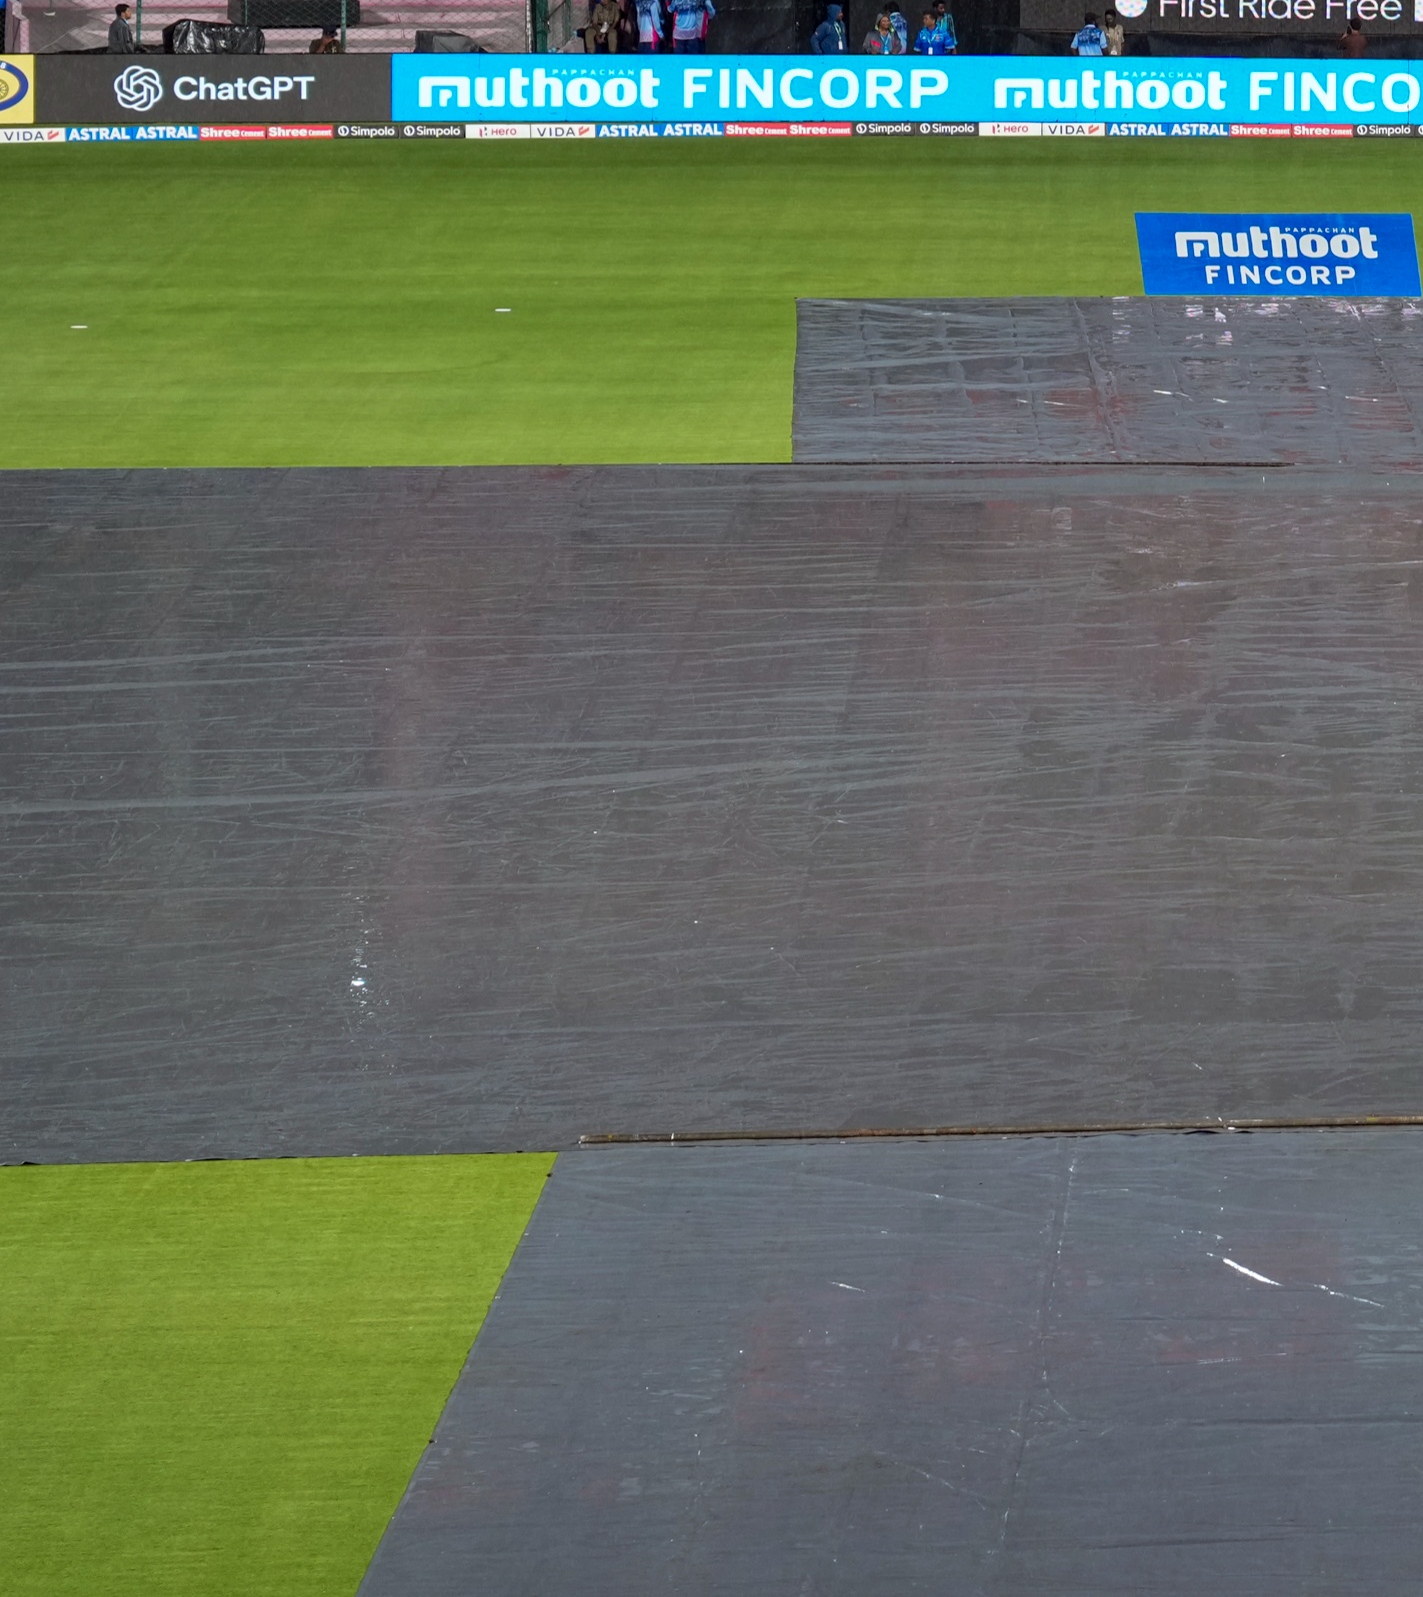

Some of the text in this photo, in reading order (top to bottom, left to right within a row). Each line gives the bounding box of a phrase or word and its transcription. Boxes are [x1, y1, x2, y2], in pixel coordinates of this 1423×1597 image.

[552, 68, 635, 76] PAPPACHAN
[173, 76, 315, 101] ChatGPT
[418, 68, 660, 108] muthoot
[683, 68, 949, 109] FINCORP
[994, 70, 1226, 110] muthoot
[136, 126, 198, 140] ASTRAL
[726, 124, 763, 135] Shree
[869, 123, 911, 135] Simpolo
[1048, 125, 1085, 134] VIDA
[1110, 122, 1166, 135] ASTRAL
[1175, 226, 1378, 259] muthoot
[1205, 265, 1355, 285] FINCORP
